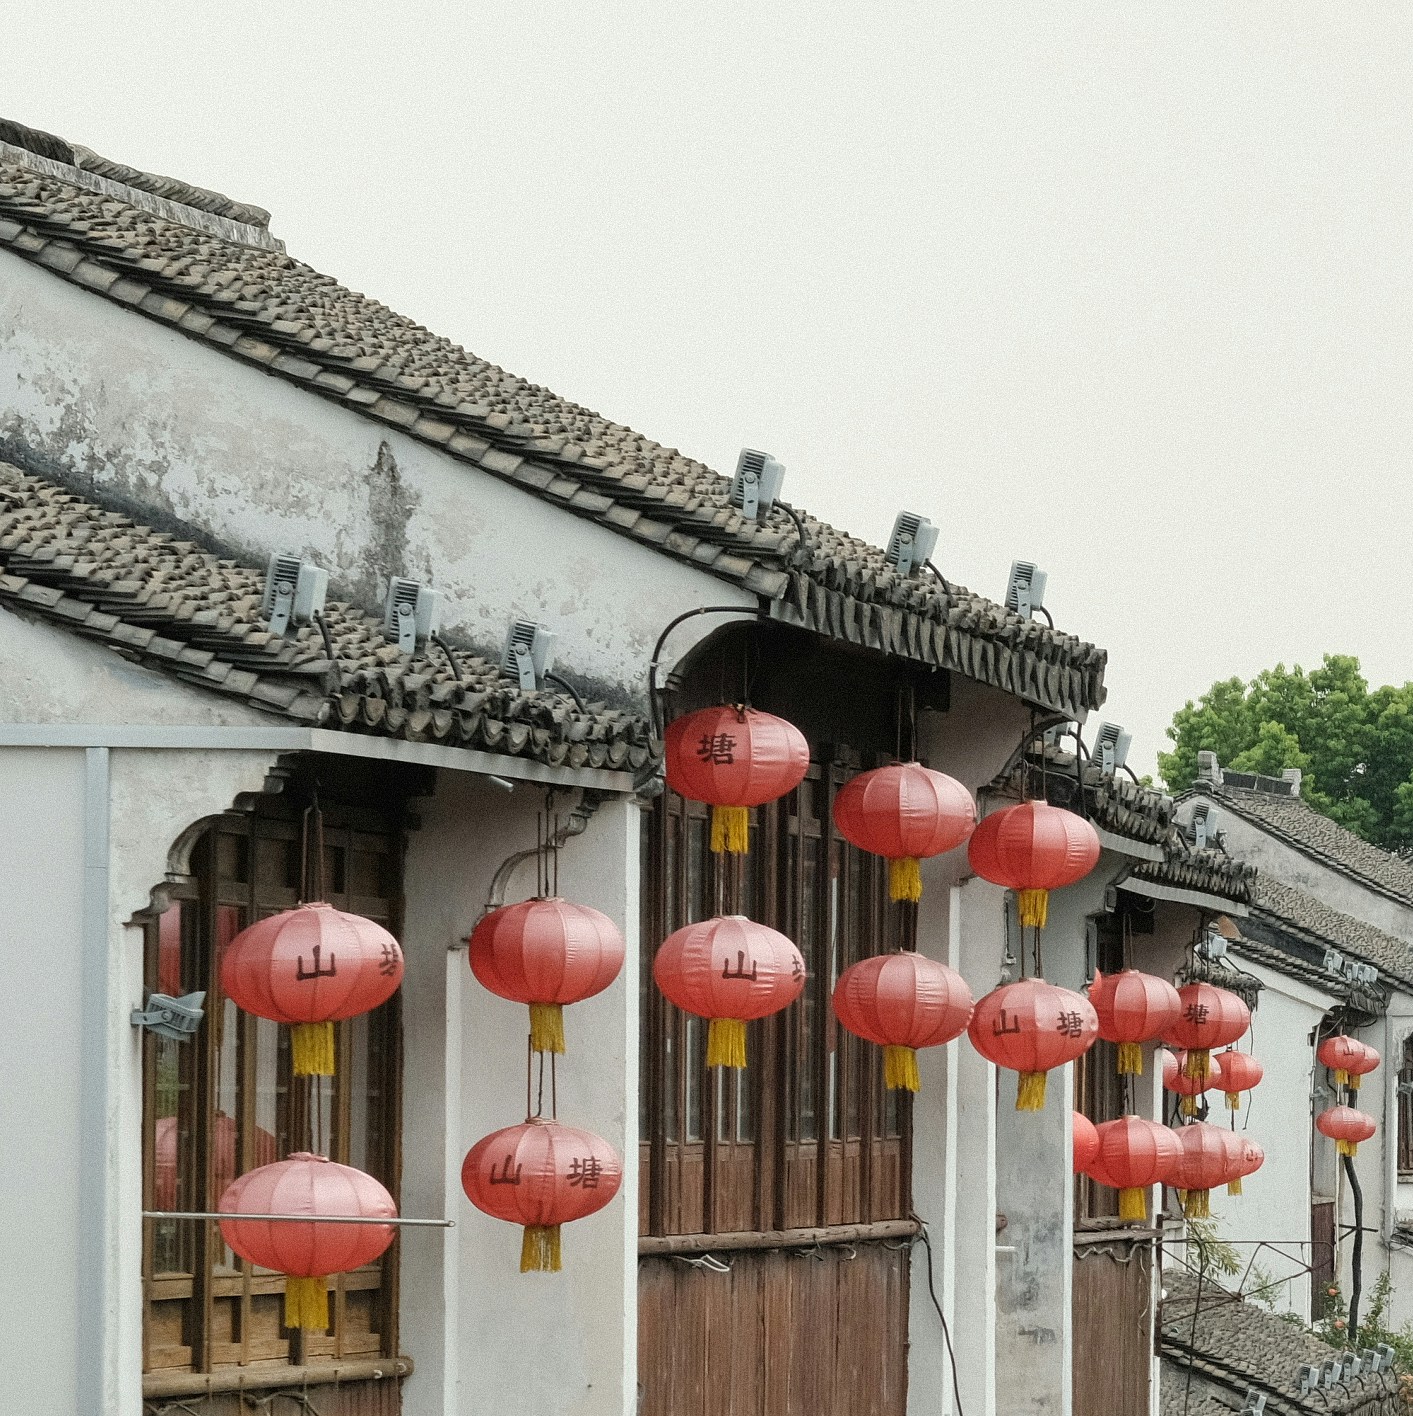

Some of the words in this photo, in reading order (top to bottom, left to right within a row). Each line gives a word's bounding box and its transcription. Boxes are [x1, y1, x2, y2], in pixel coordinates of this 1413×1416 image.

[697, 732, 737, 766] 塘
[992, 1007, 1083, 1039] 山塘
[1183, 1003, 1209, 1025] 塘
[490, 1153, 603, 1189] 山塘
